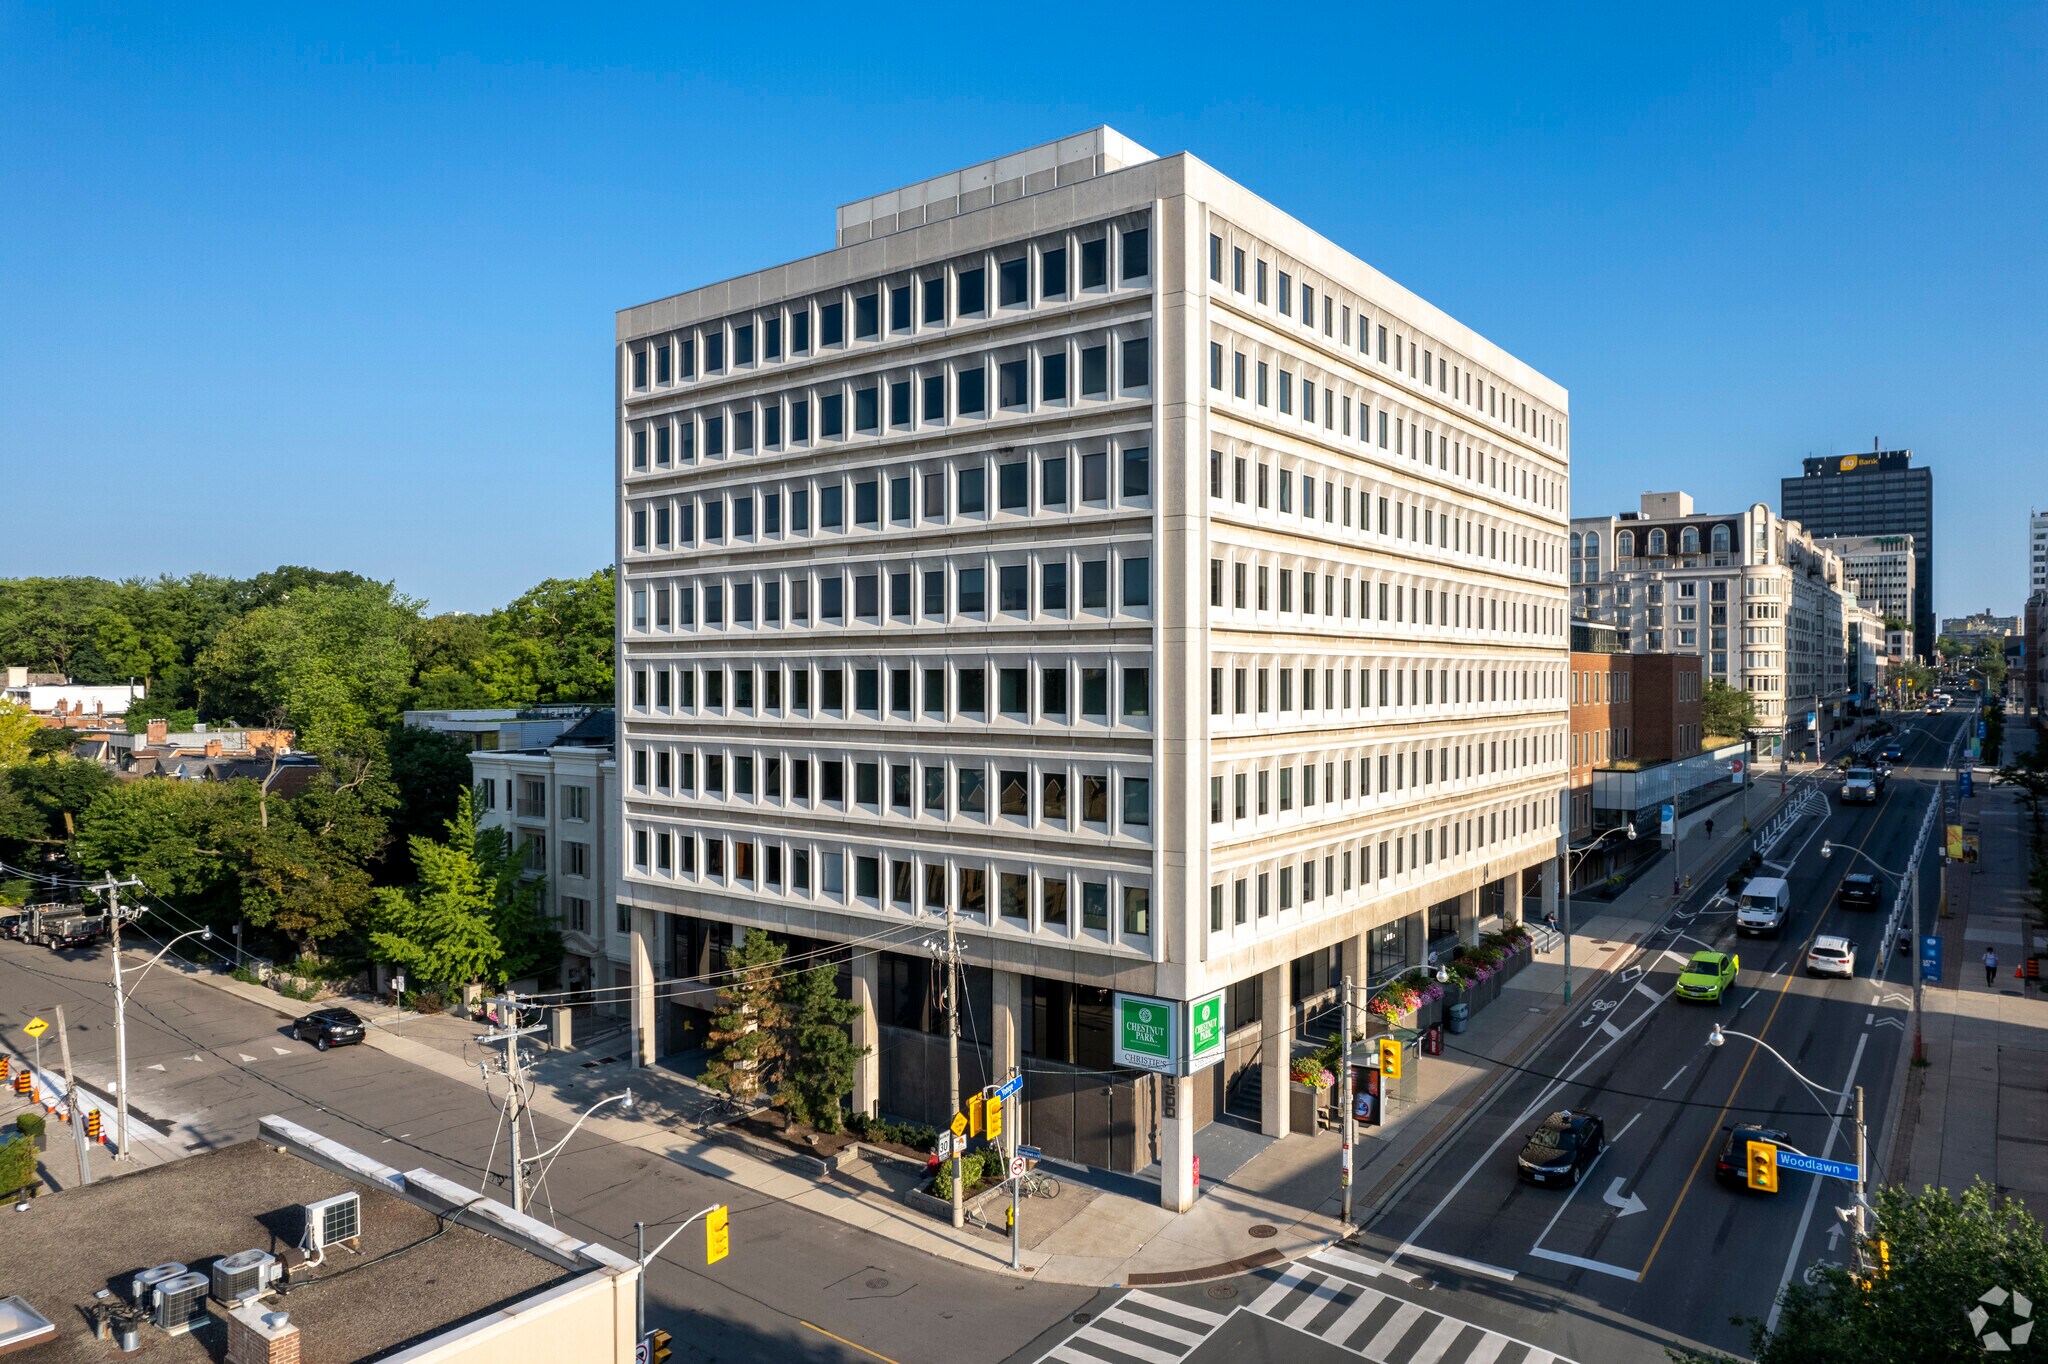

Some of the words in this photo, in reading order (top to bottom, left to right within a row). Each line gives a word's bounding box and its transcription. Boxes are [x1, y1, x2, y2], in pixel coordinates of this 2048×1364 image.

[1859, 458, 1879, 466] Bank
[1126, 1021, 1164, 1036] CHESTNUT
[1195, 1018, 1217, 1035] CHESTNUT
[1135, 1031, 1155, 1043] PARK
[1124, 1053, 1168, 1068] CHRISTIE'S
[1001, 1084, 1014, 1096] Yonge
[940, 1140, 948, 1152] 30
[1780, 1153, 1840, 1174] Woodlawn
